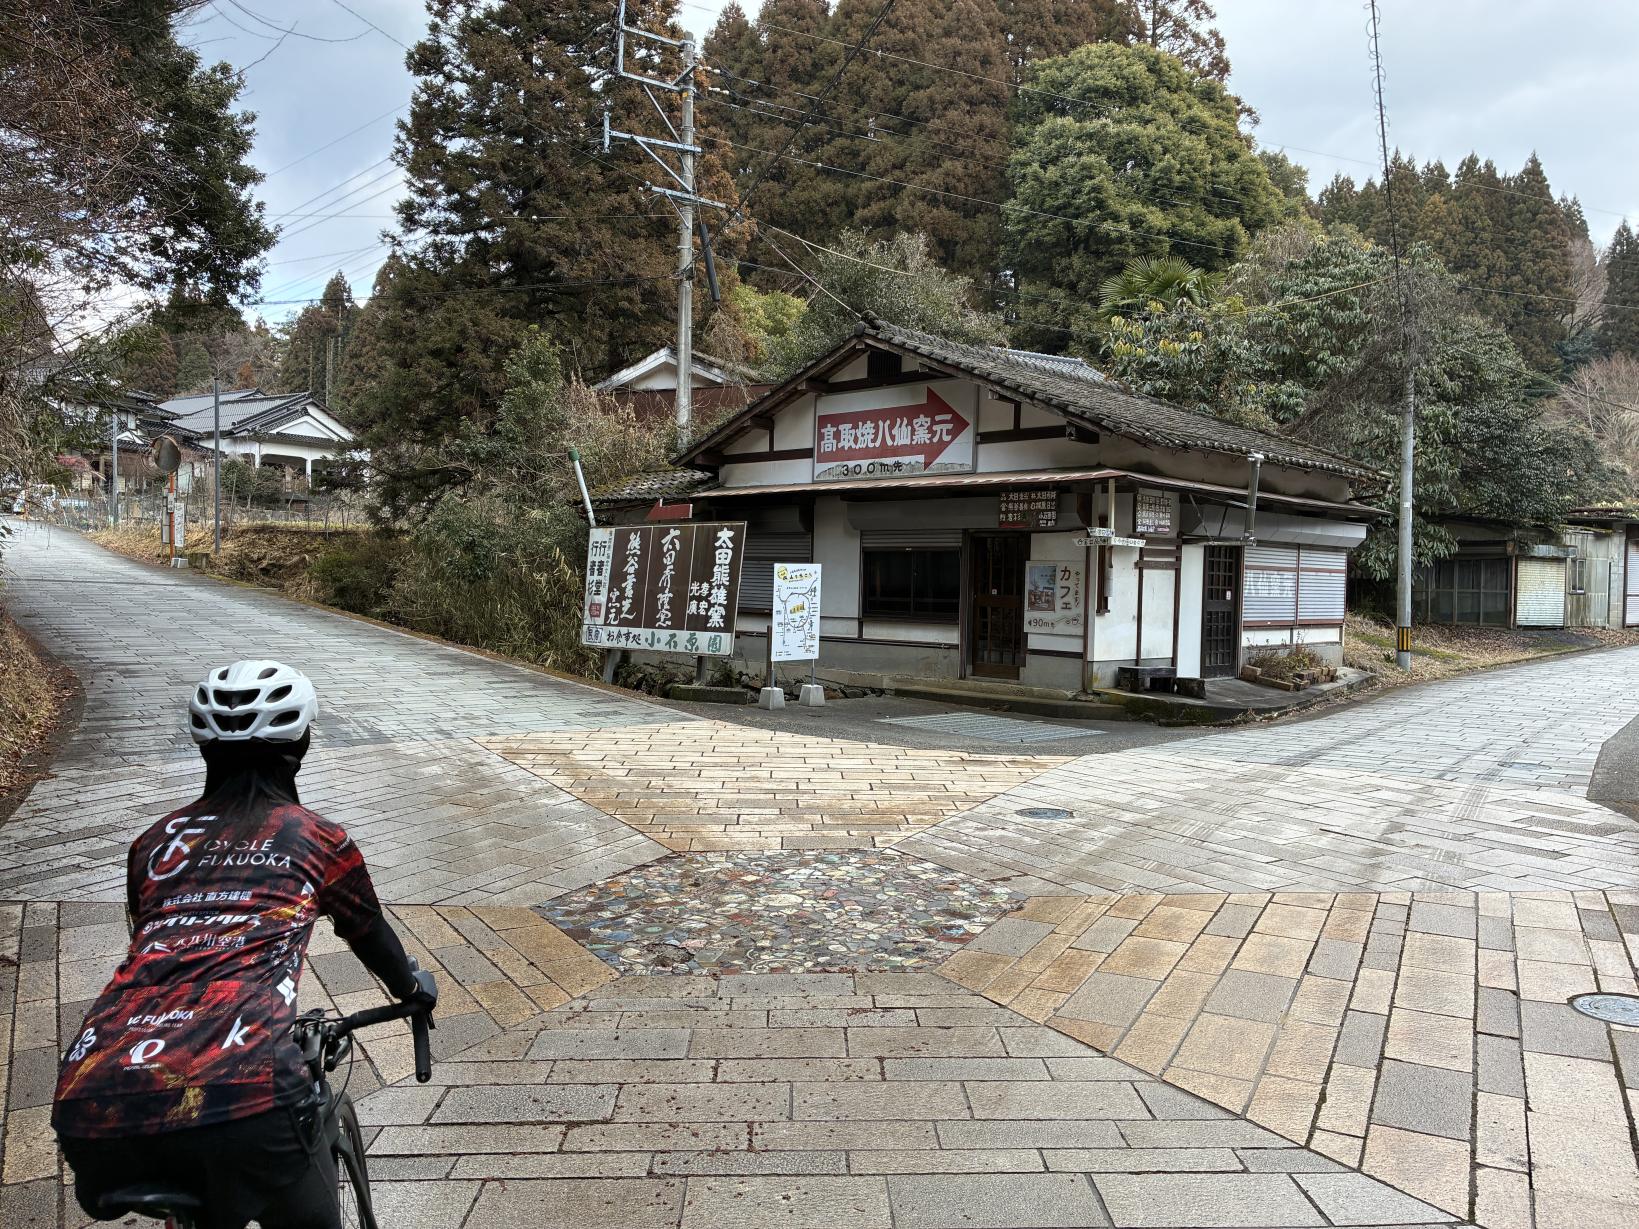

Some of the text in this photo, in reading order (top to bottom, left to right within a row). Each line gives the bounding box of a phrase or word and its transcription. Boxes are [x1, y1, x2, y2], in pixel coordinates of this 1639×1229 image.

[820, 413, 954, 453] 高取焼八仙窯元
[706, 527, 735, 628] 太田熊雄窯
[1060, 566, 1072, 610] カフェ
[607, 630, 642, 647] お食事処
[645, 630, 723, 653] 小石原園
